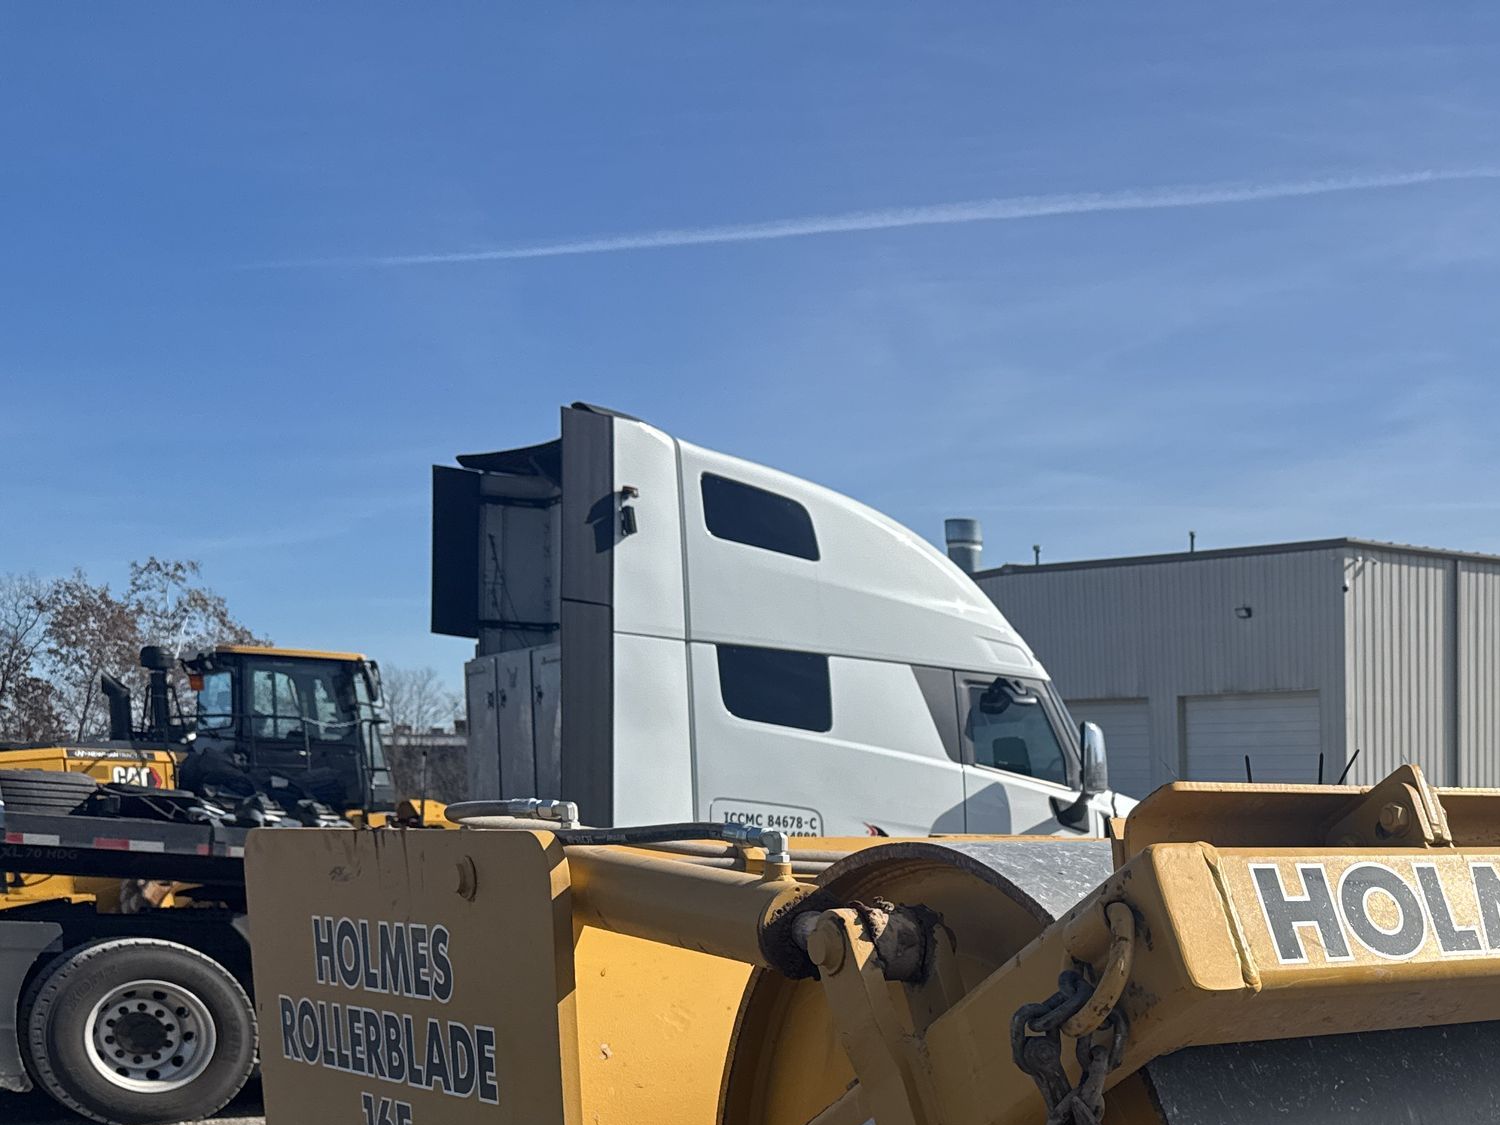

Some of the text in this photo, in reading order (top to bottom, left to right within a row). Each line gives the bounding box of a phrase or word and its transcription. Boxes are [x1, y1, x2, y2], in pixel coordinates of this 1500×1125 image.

[112, 766, 150, 787] CAT
[767, 814, 817, 830] 84678-C
[311, 915, 454, 1004] HOLMES
[279, 994, 500, 1105] ROLLERBLADE
